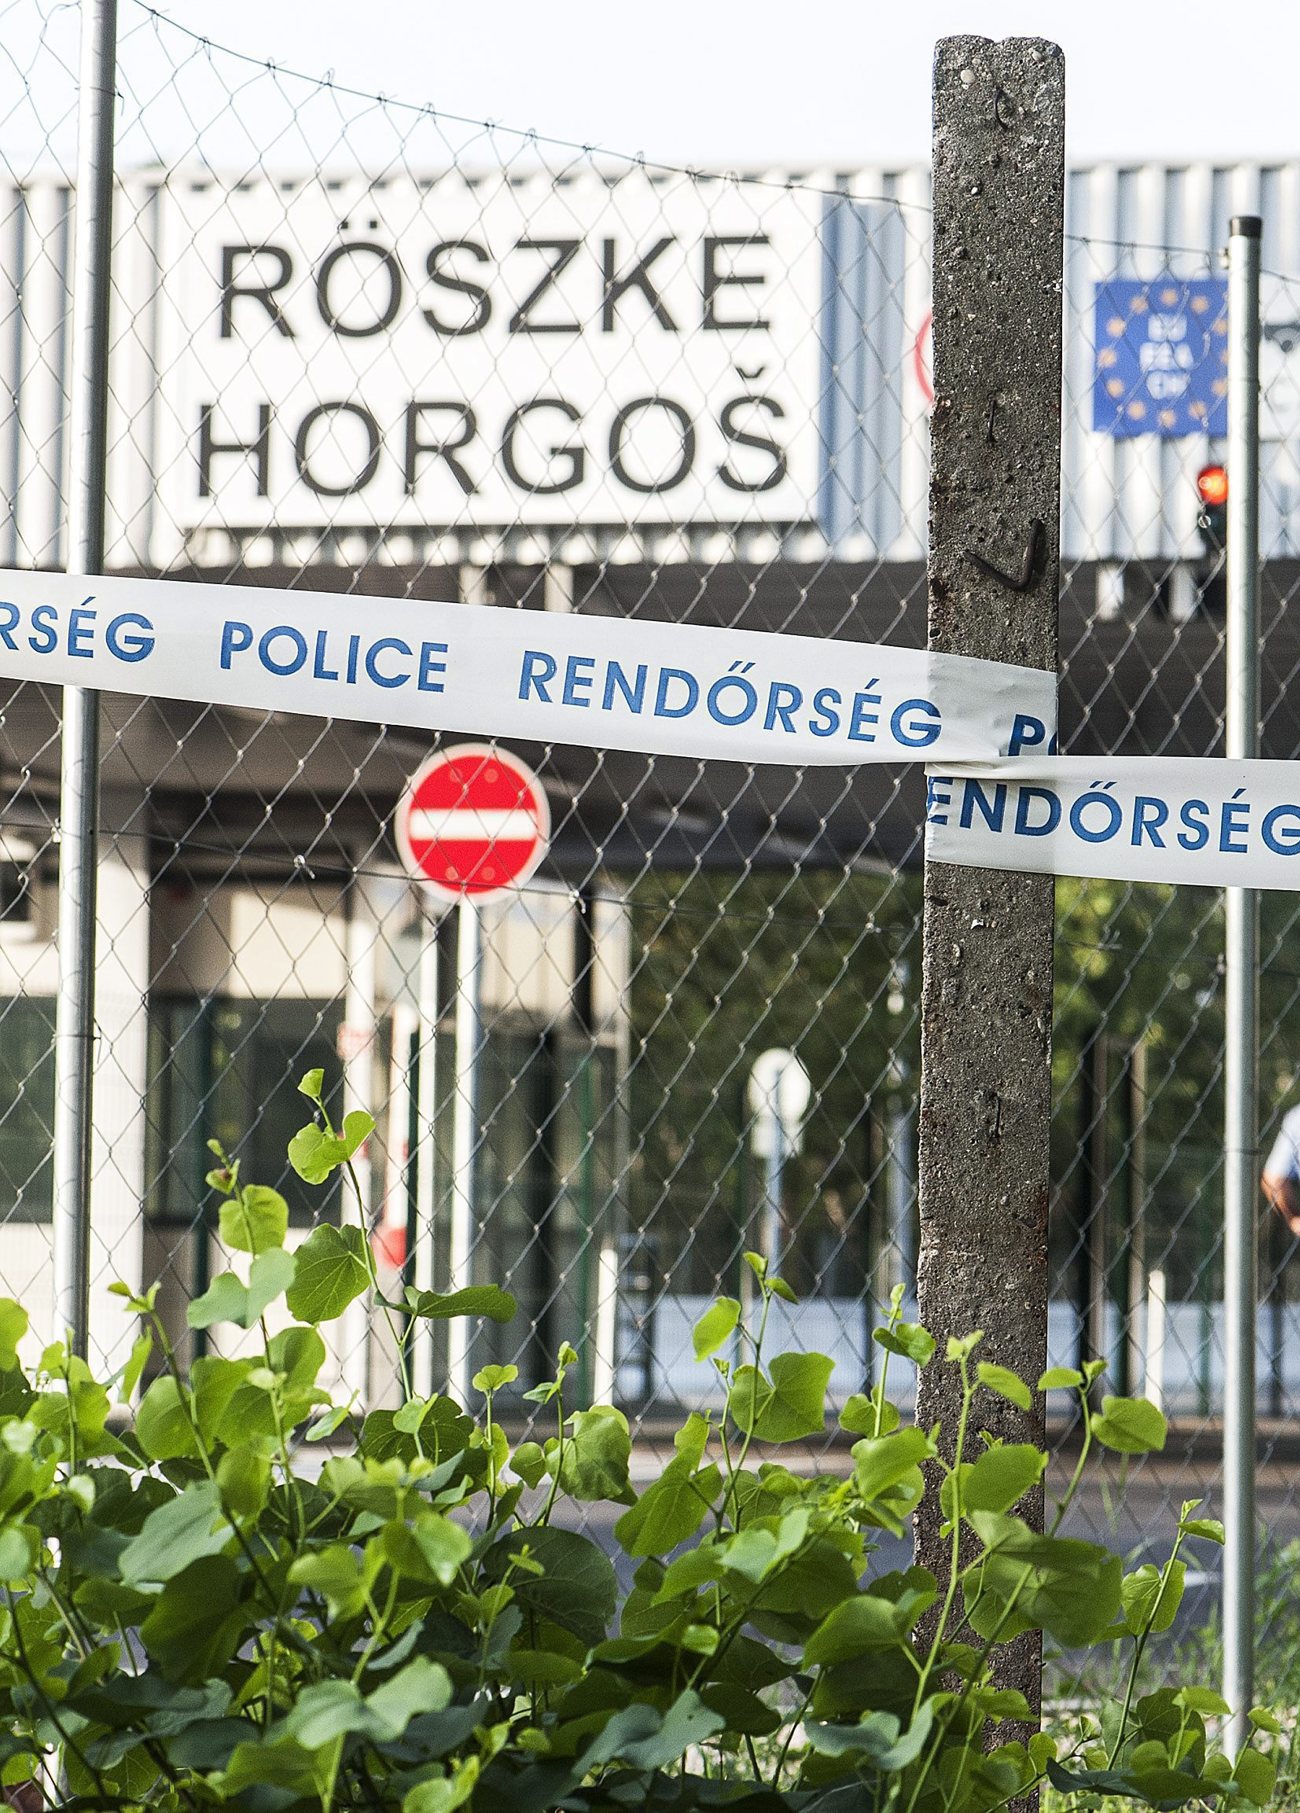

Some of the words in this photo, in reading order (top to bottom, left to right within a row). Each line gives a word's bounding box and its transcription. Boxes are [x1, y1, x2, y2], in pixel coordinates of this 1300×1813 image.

[219, 219, 773, 339] RÖSZKE
[199, 365, 789, 498] HORGOŠ
[220, 622, 450, 695] POLICE
[518, 652, 942, 749] RENDŐRSÉG
[1008, 713, 1058, 757] P
